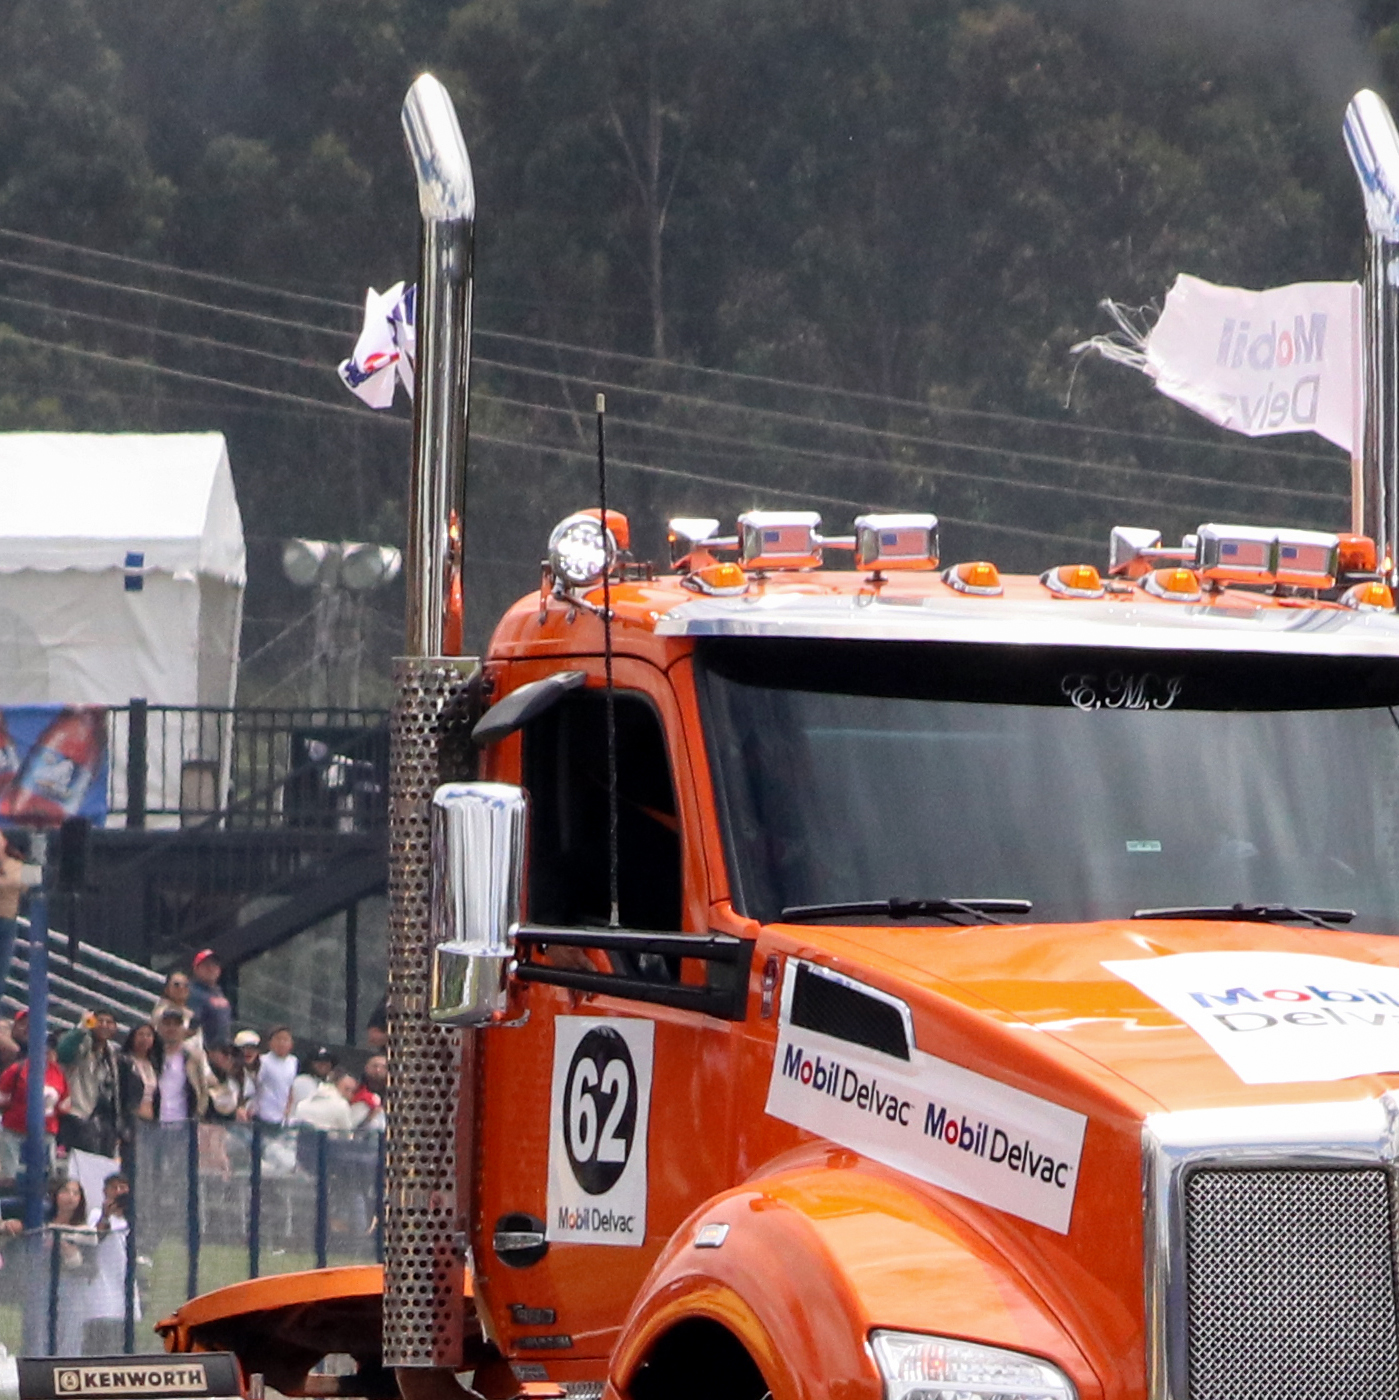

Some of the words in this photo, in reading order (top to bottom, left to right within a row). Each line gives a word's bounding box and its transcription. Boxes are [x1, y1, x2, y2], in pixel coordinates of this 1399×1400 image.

[569, 1056, 631, 1164] 62
[782, 1044, 840, 1095] Mobil
[923, 1102, 988, 1158] Mobil
[558, 1206, 590, 1230] Mobil
[84, 1370, 203, 1389] KENWORTH
